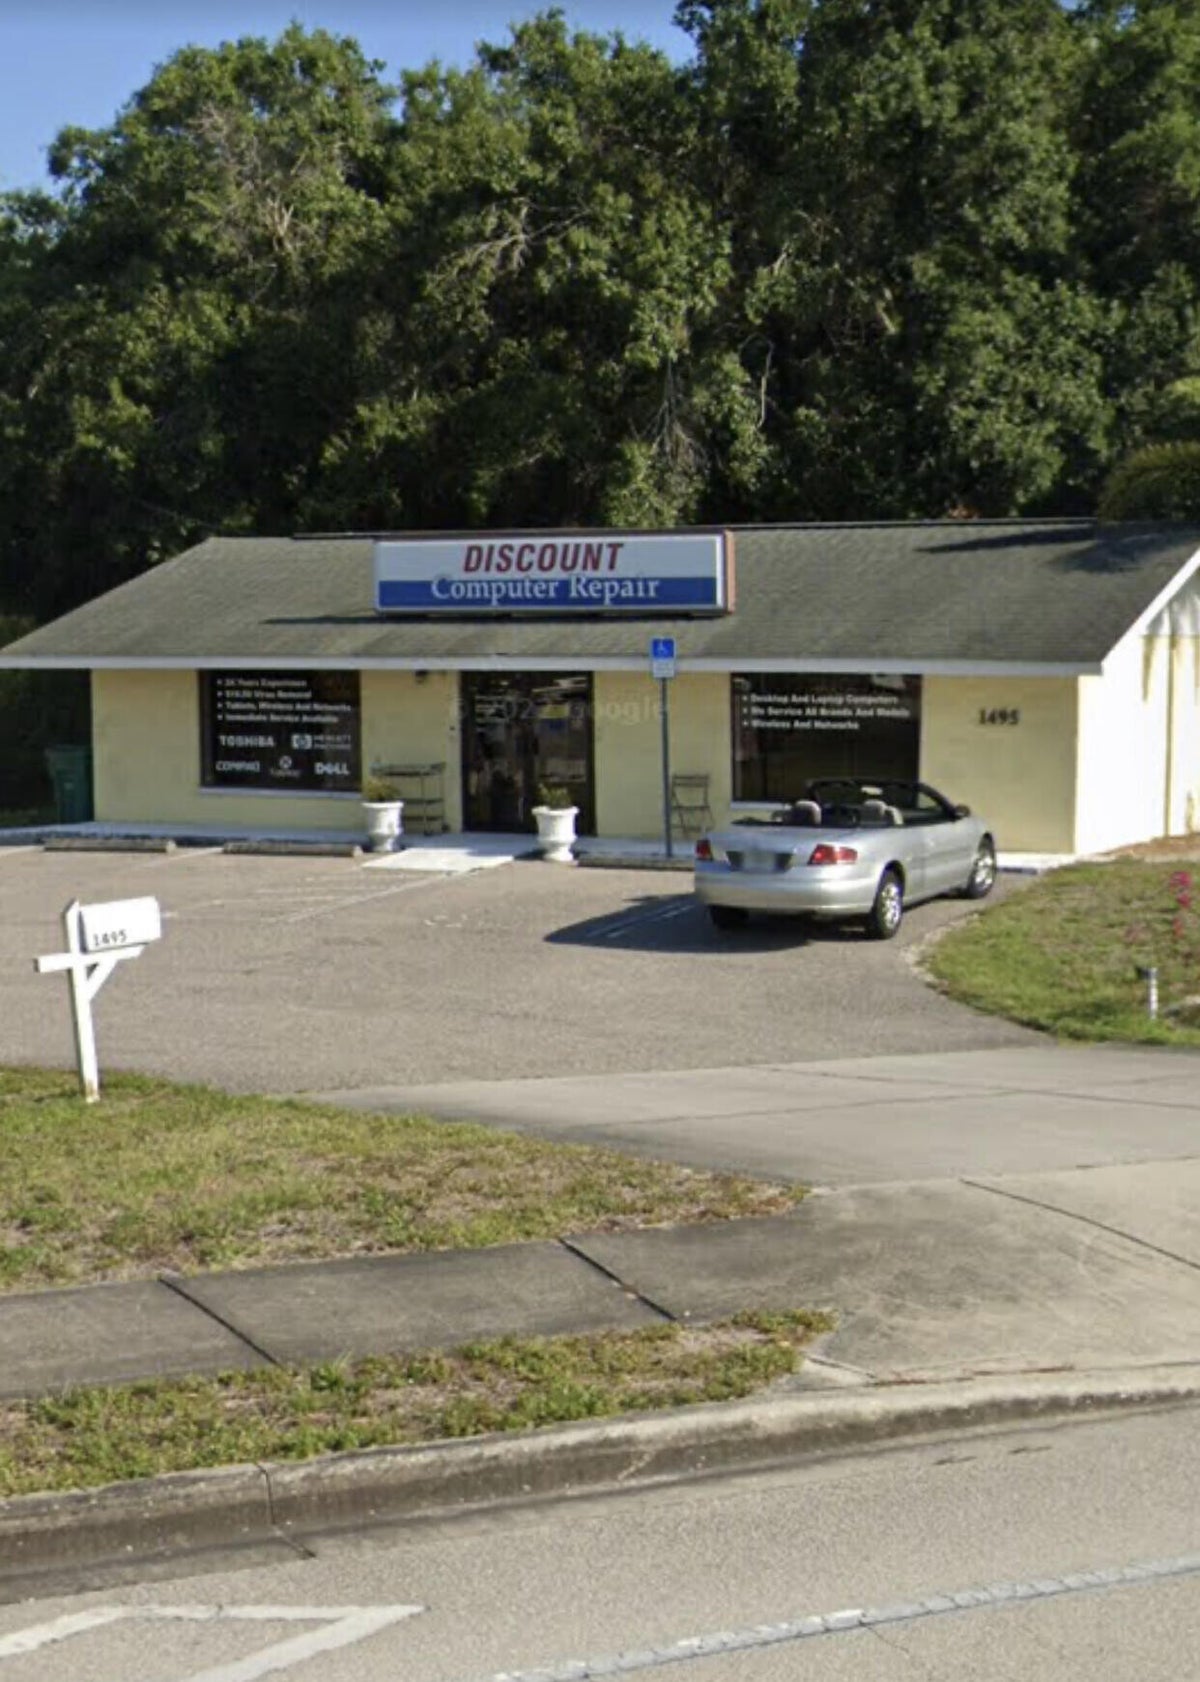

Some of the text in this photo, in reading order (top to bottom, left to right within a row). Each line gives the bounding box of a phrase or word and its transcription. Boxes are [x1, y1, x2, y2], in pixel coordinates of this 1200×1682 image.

[463, 543, 624, 572] DISCOUNT
[430, 574, 660, 604] Computer Repair
[791, 693, 809, 703] And
[811, 693, 844, 705] Laptop
[846, 693, 899, 705] Computers
[767, 706, 803, 716] Service
[805, 707, 818, 716] All
[820, 707, 853, 717] Brands
[855, 708, 874, 717] And
[979, 708, 1019, 725] 1495
[793, 719, 812, 729] And
[219, 734, 275, 748] TOSHIBA
[314, 761, 350, 775] DELL
[93, 929, 127, 946] 1495
